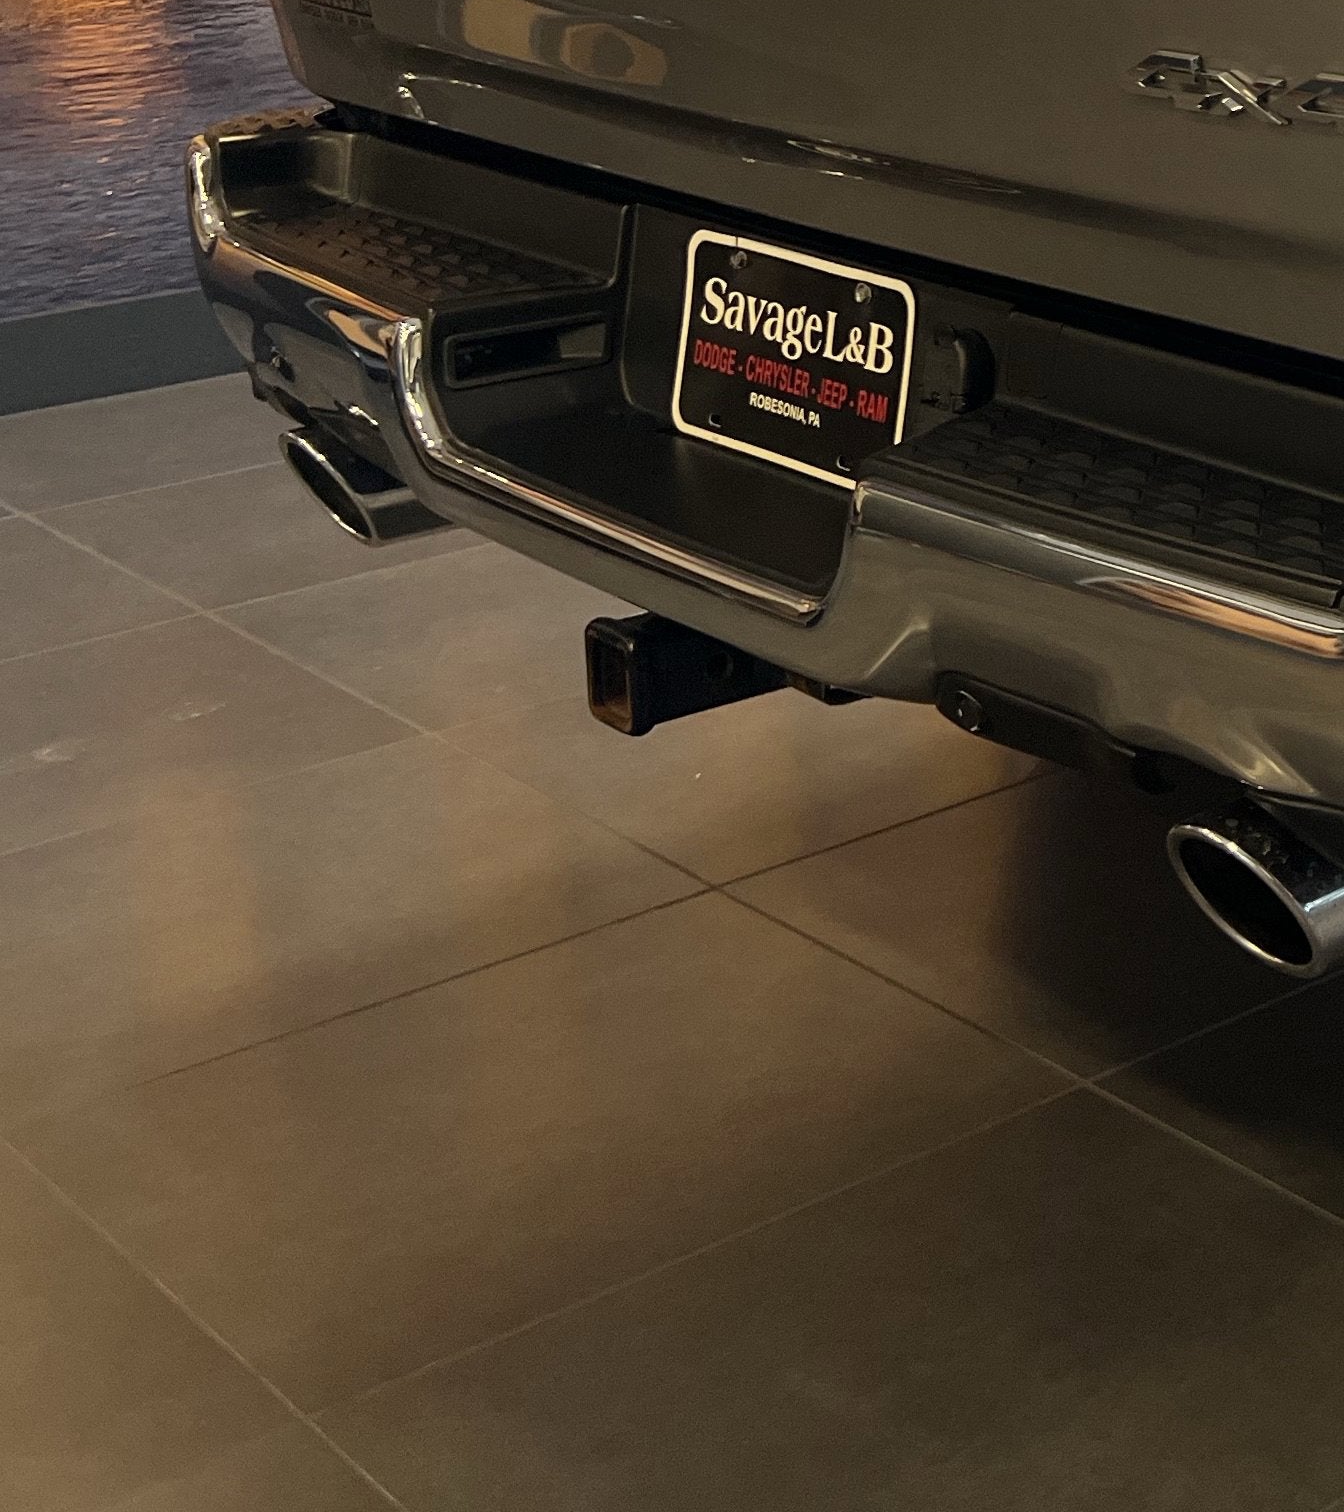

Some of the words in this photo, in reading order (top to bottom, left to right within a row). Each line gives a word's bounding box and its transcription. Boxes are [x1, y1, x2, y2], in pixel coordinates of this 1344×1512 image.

[693, 339, 737, 375] DODGE
[745, 355, 809, 398] CHRYSLER
[816, 377, 848, 410] JEEP
[856, 389, 889, 424] RAM
[749, 391, 806, 425] ROBESONIA,
[807, 410, 822, 428] PA
